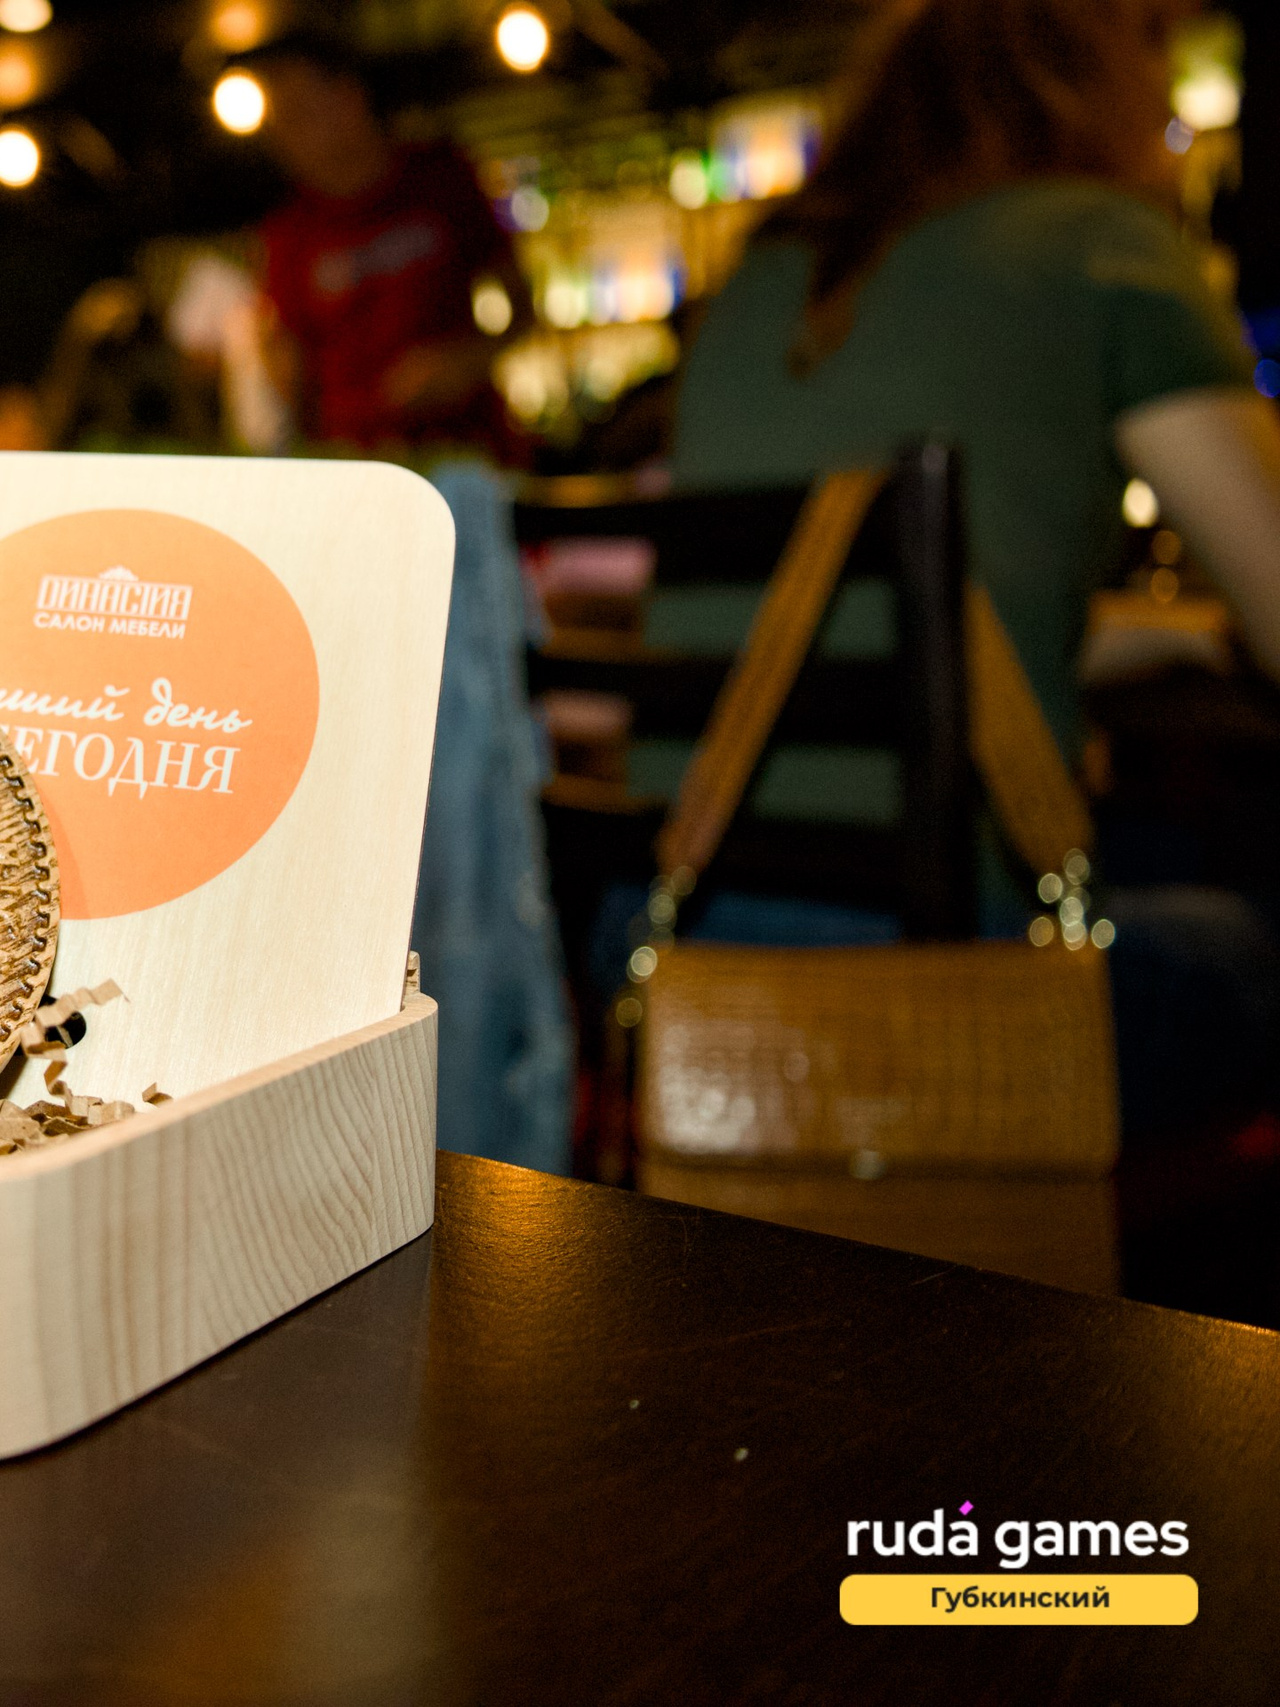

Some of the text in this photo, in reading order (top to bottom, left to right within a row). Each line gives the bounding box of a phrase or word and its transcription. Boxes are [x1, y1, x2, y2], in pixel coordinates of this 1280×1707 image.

[33, 610, 187, 640] САЛОН МЕБЕЛИ
[143, 677, 253, 734] день
[0, 722, 241, 800] ЕГОДНЯ
